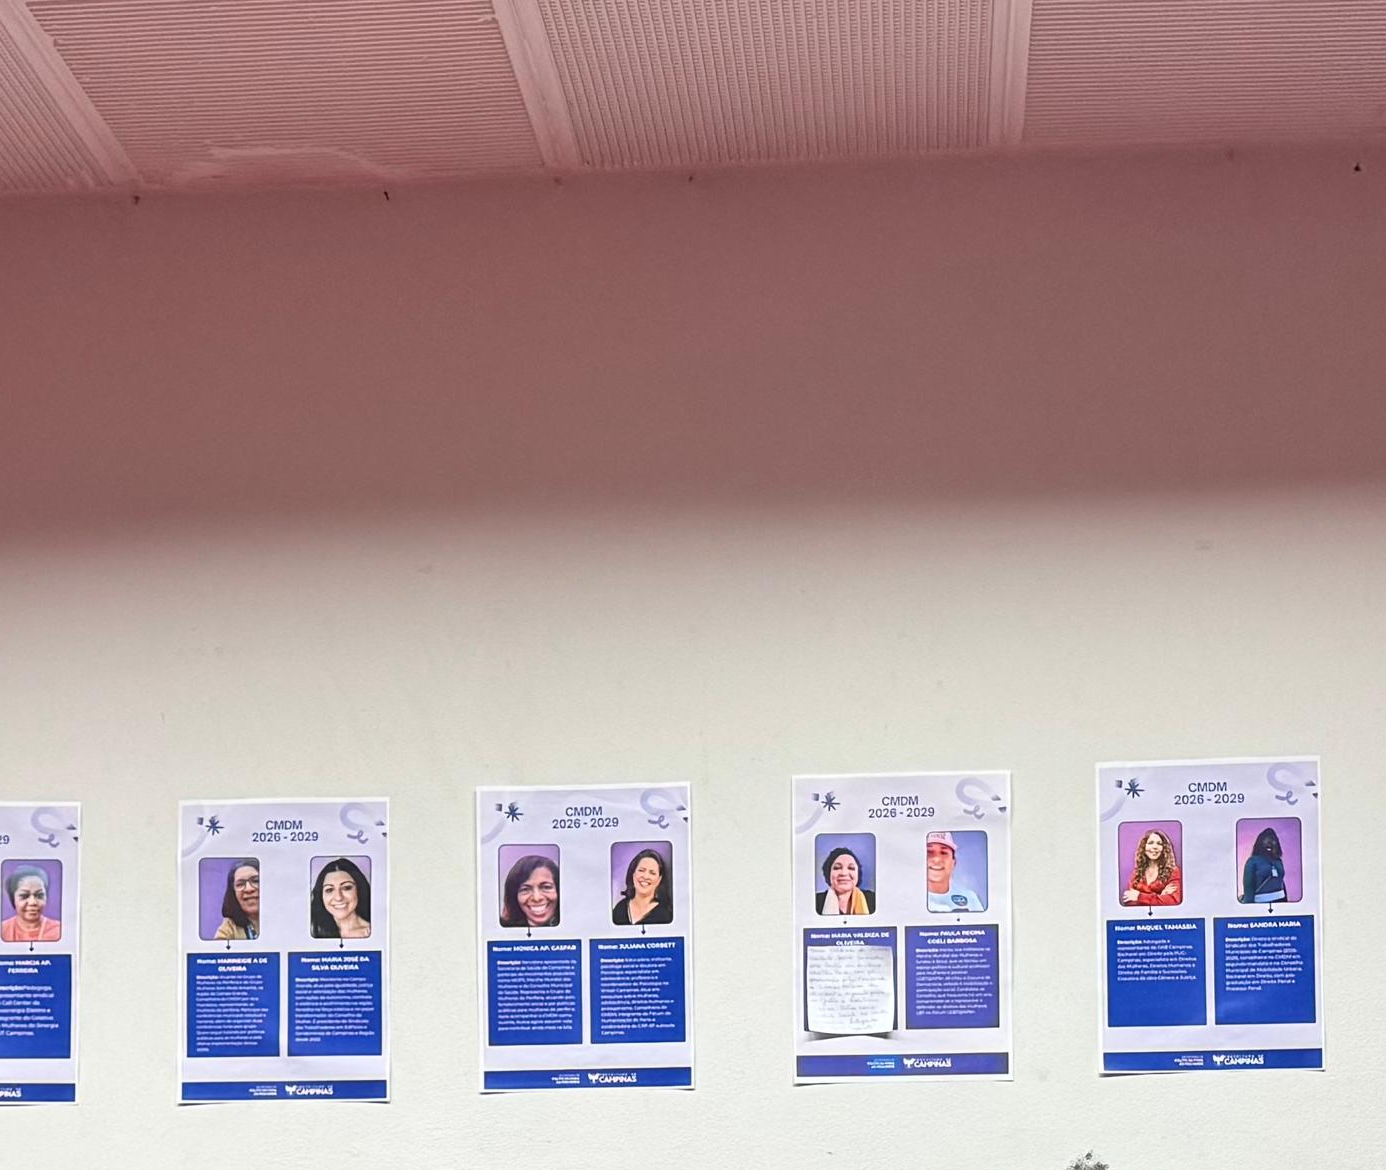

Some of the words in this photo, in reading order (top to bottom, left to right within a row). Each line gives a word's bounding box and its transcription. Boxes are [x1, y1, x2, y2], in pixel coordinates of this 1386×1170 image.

[1188, 782, 1227, 792] CMDM
[882, 796, 918, 806] CMDM
[1174, 795, 1204, 805] 2026
[1214, 793, 1245, 804] 2029
[565, 806, 602, 817] CMDM
[868, 809, 897, 818] 2026
[906, 807, 935, 817] 2029
[265, 820, 302, 830] CMDM
[552, 819, 580, 829] 2026
[590, 817, 619, 828] 2029
[252, 832, 281, 842] 2026
[290, 831, 318, 841] 2029
[1136, 924, 1163, 932] RAQUEL
[1278, 920, 1301, 928] MARIA
[914, 1059, 951, 1068] CAMPINAS
[1224, 1057, 1264, 1065] CAMPINAS
[599, 1075, 637, 1083] CAMPINAS
[296, 1088, 333, 1096] CAMPINAS
